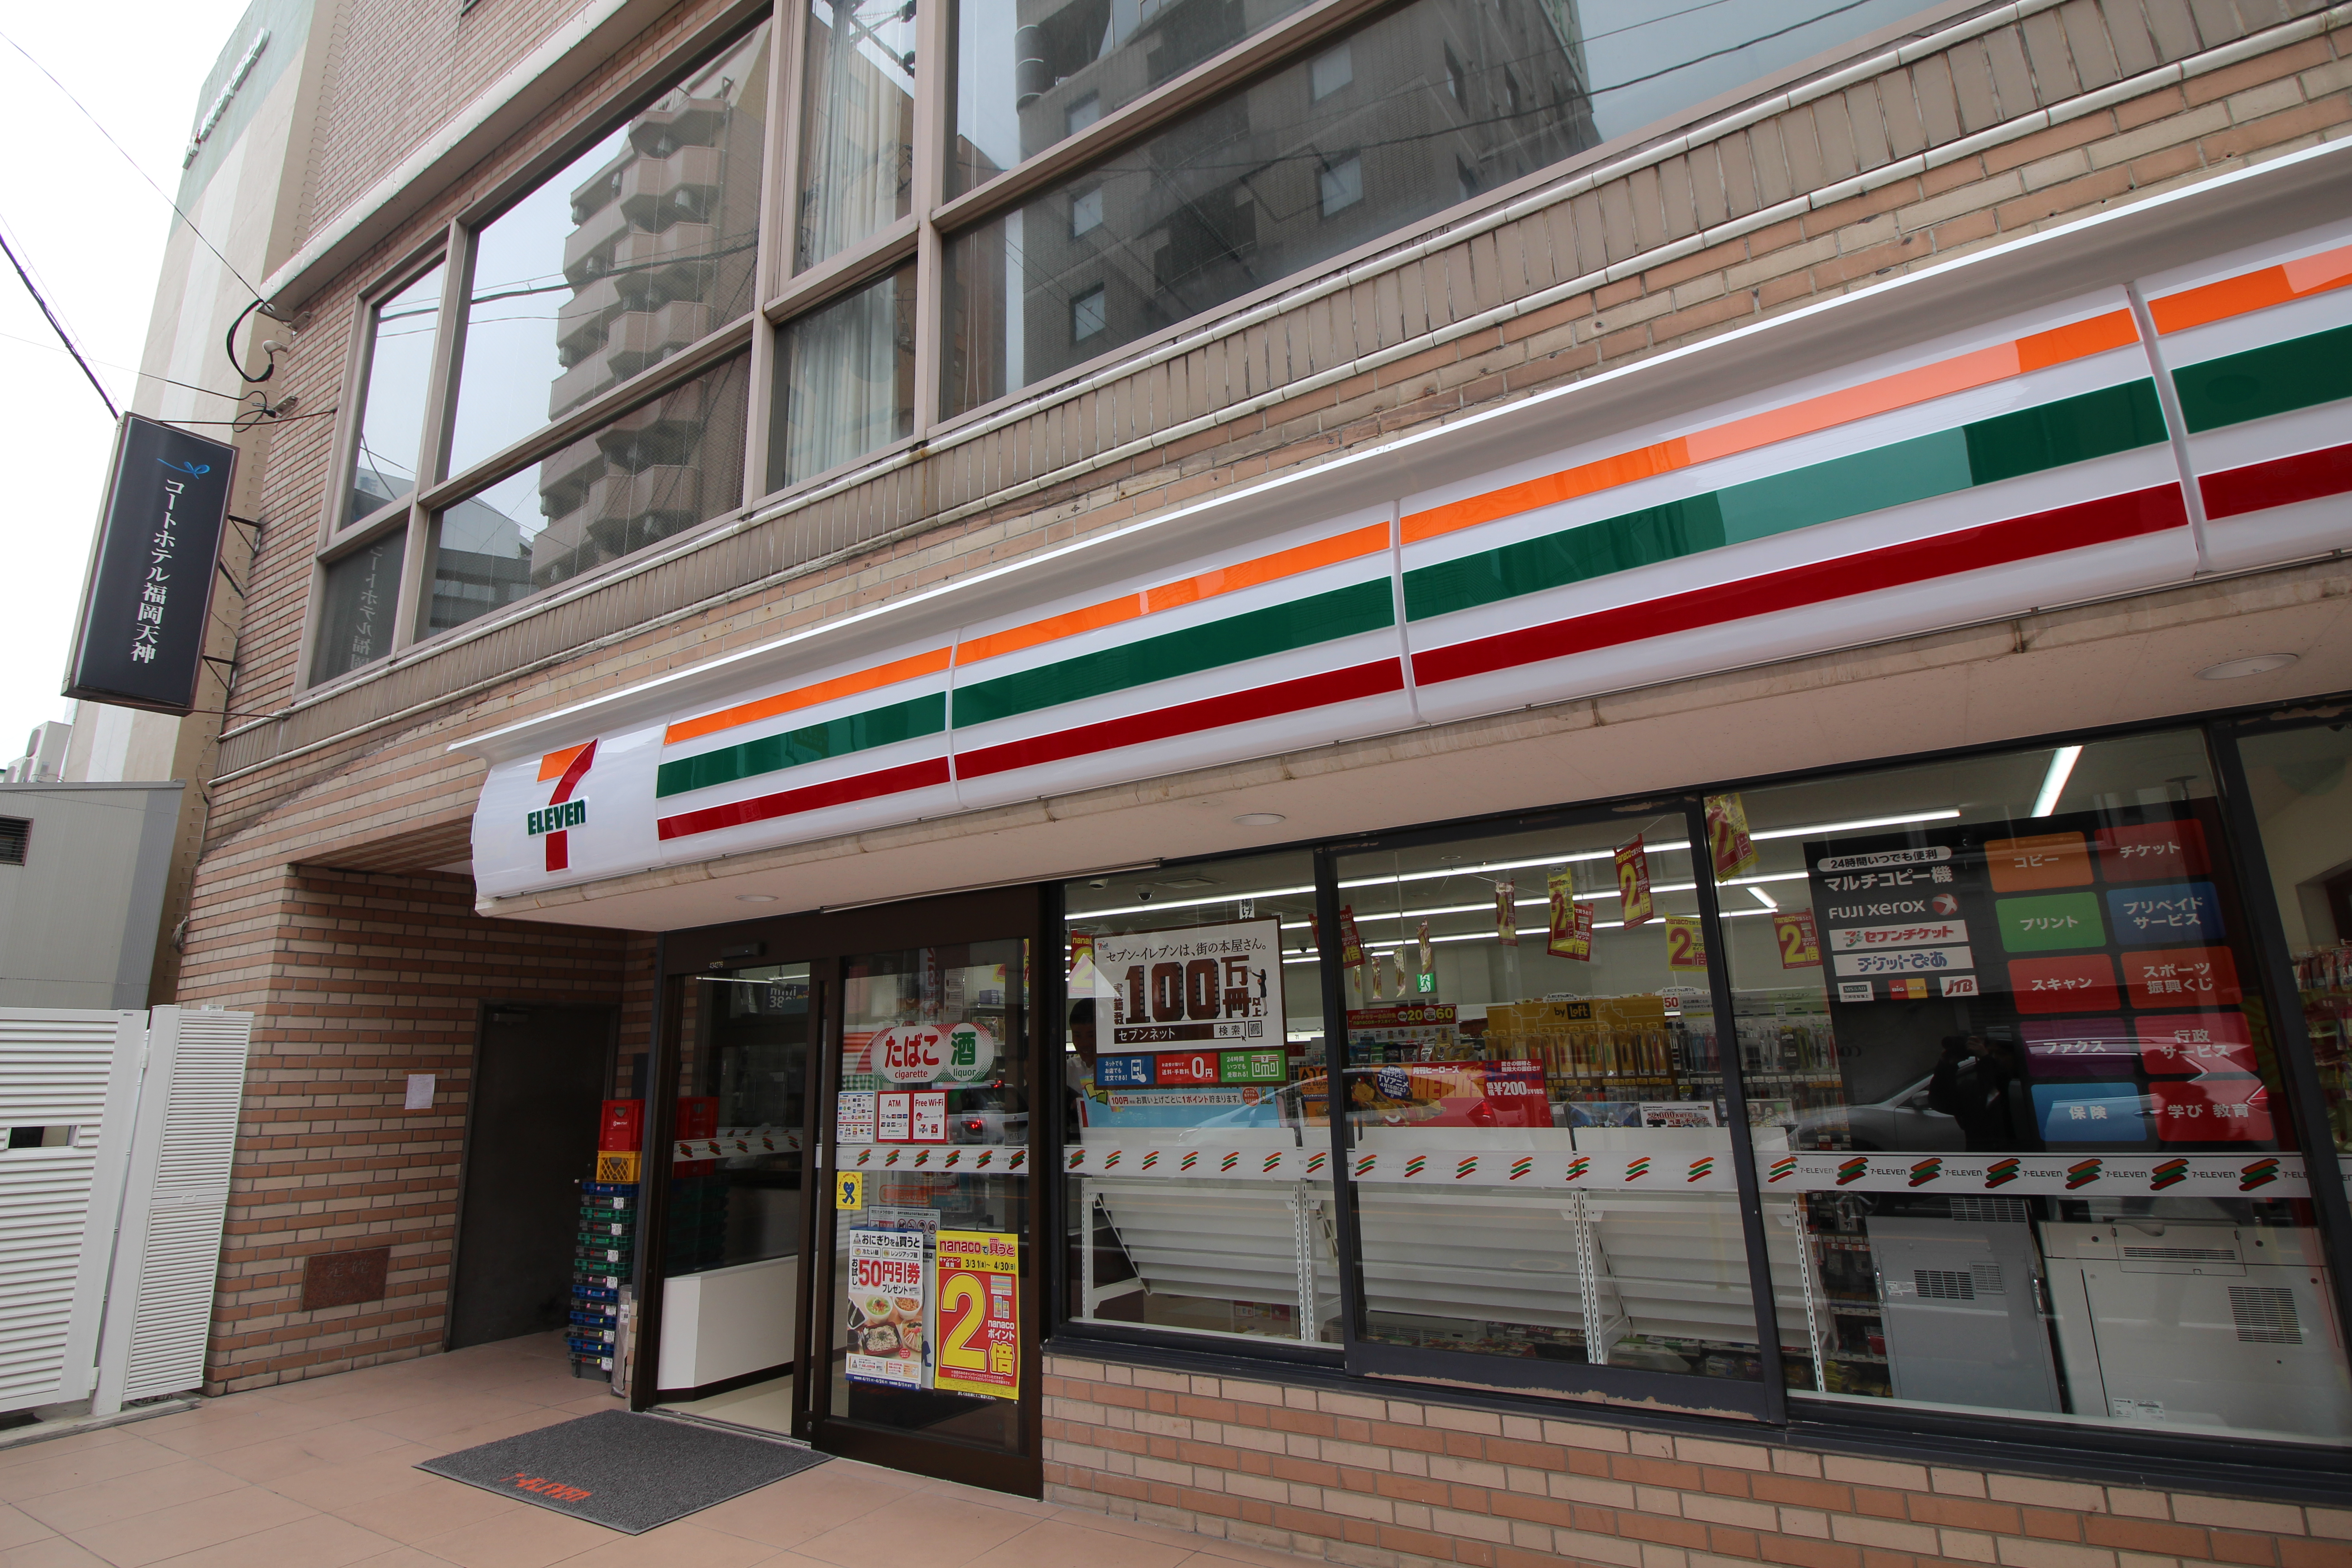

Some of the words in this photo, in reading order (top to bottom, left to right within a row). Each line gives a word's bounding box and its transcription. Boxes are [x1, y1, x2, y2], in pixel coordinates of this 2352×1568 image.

[130, 478, 185, 664] コートホテル福岡天神
[1707, 804, 1739, 875] 2
[1734, 830, 1752, 860] 倍
[2120, 841, 2180, 858] チケット
[1830, 849, 1937, 869] 24時間いつでも便利
[2014, 855, 2059, 868] コピー
[1824, 866, 1953, 892] マルチコピー機
[1620, 862, 1642, 922] 2
[1241, 899, 1253, 919] 揚げ
[1639, 891, 1651, 916] 倍
[2123, 897, 2203, 915] プリペイド
[1551, 890, 1566, 941] 2
[1828, 906, 1863, 919] FUJI
[2020, 916, 2078, 931] プリント
[2133, 913, 2201, 929] サービス
[1864, 925, 1954, 943] セブンチケット
[1106, 938, 1266, 963] セブン-イレブンは、街の本屋さん。
[1669, 926, 1693, 966] 2
[1779, 923, 1807, 964] 2
[1346, 944, 1362, 962] 倍
[1805, 946, 1820, 961] 倍
[1857, 951, 1947, 972] チケットぴあ
[2143, 961, 2210, 978] スポーツ
[1945, 979, 1973, 996] JTB
[2031, 976, 2092, 992] スキャン
[2147, 977, 2213, 994] 振興くじ
[1251, 997, 1262, 1017] 以上
[1664, 997, 1679, 1008] 50
[1407, 1009, 1423, 1021] 20
[1436, 1007, 1454, 1019] 60
[1554, 1007, 1565, 1018] by
[1118, 1027, 1176, 1042] セブンネット
[1218, 1024, 1240, 1036] 検索
[2174, 1029, 2209, 1044] 行政
[885, 1033, 939, 1068] たばこ
[951, 1031, 976, 1066] 酒
[2043, 1041, 2106, 1054] ファクス
[2160, 1044, 2231, 1059] サービス
[895, 1070, 928, 1079] cigarette
[953, 1068, 976, 1078] liquor
[1191, 1056, 1213, 1079] 0円
[1388, 1065, 1401, 1073] NHK
[1412, 1065, 1460, 1074] 月刊ヒーローズ
[1377, 1074, 1409, 1088] TVアニメ
[1486, 1082, 1494, 1096] 価格
[928, 1098, 944, 1107] Wi-Fi
[2167, 1104, 2202, 1118] 学び
[2212, 1103, 2249, 1118] 教育
[2068, 1105, 2108, 1120] 保険
[891, 1250, 918, 1259] レンジアップ麺
[939, 1237, 1015, 1257] nanacoで買うと
[858, 1259, 920, 1287] 50円引券
[882, 1284, 908, 1295] プレゼント
[941, 1272, 987, 1372] 2
[988, 1319, 1015, 1330] nanaco
[987, 1328, 1015, 1341] ポイント
[988, 1339, 1015, 1377] 倍
